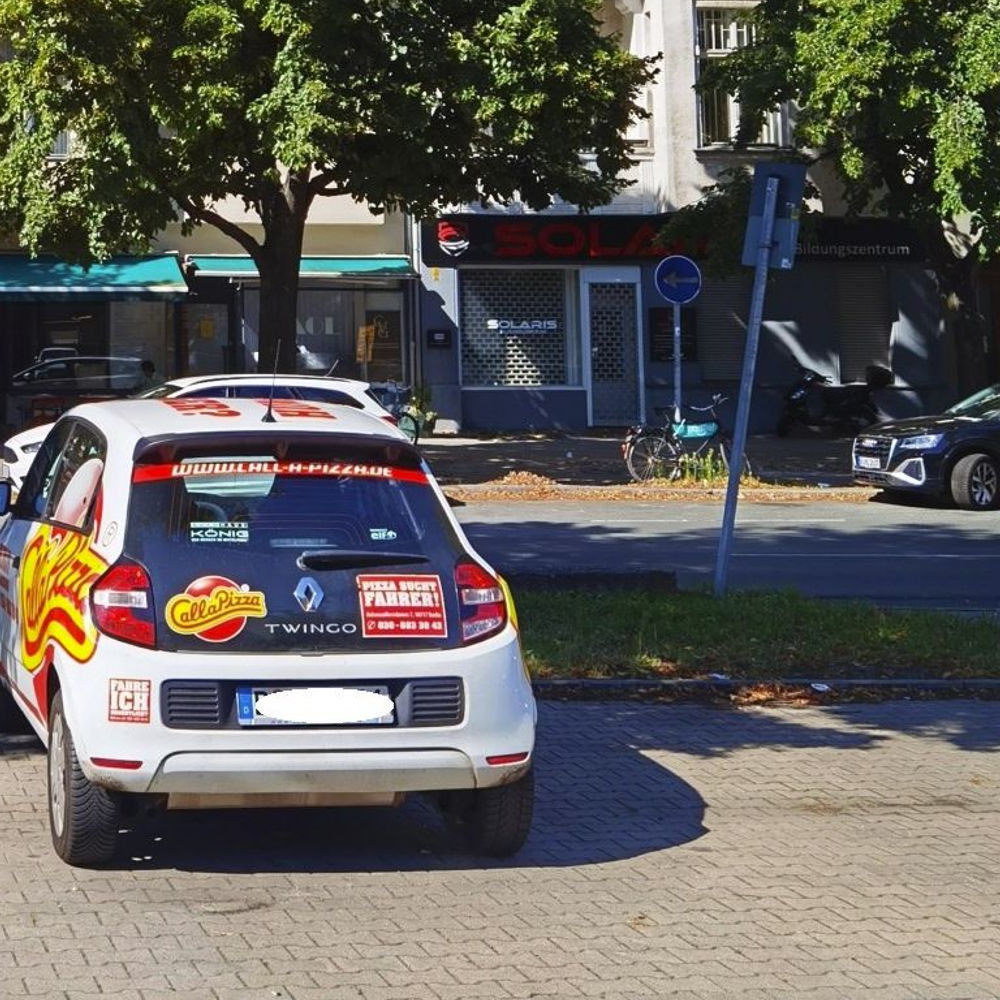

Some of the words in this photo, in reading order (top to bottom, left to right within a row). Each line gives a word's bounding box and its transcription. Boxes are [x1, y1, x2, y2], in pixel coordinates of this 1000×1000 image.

[487, 318, 558, 330] SOLARIS
[191, 527, 249, 538] KÖNIG
[362, 581, 396, 590] PIZZA
[399, 581, 437, 590] SUCHT
[364, 592, 440, 607] FAHRER!
[265, 623, 357, 633] TWINGO
[111, 692, 149, 710] ICH
